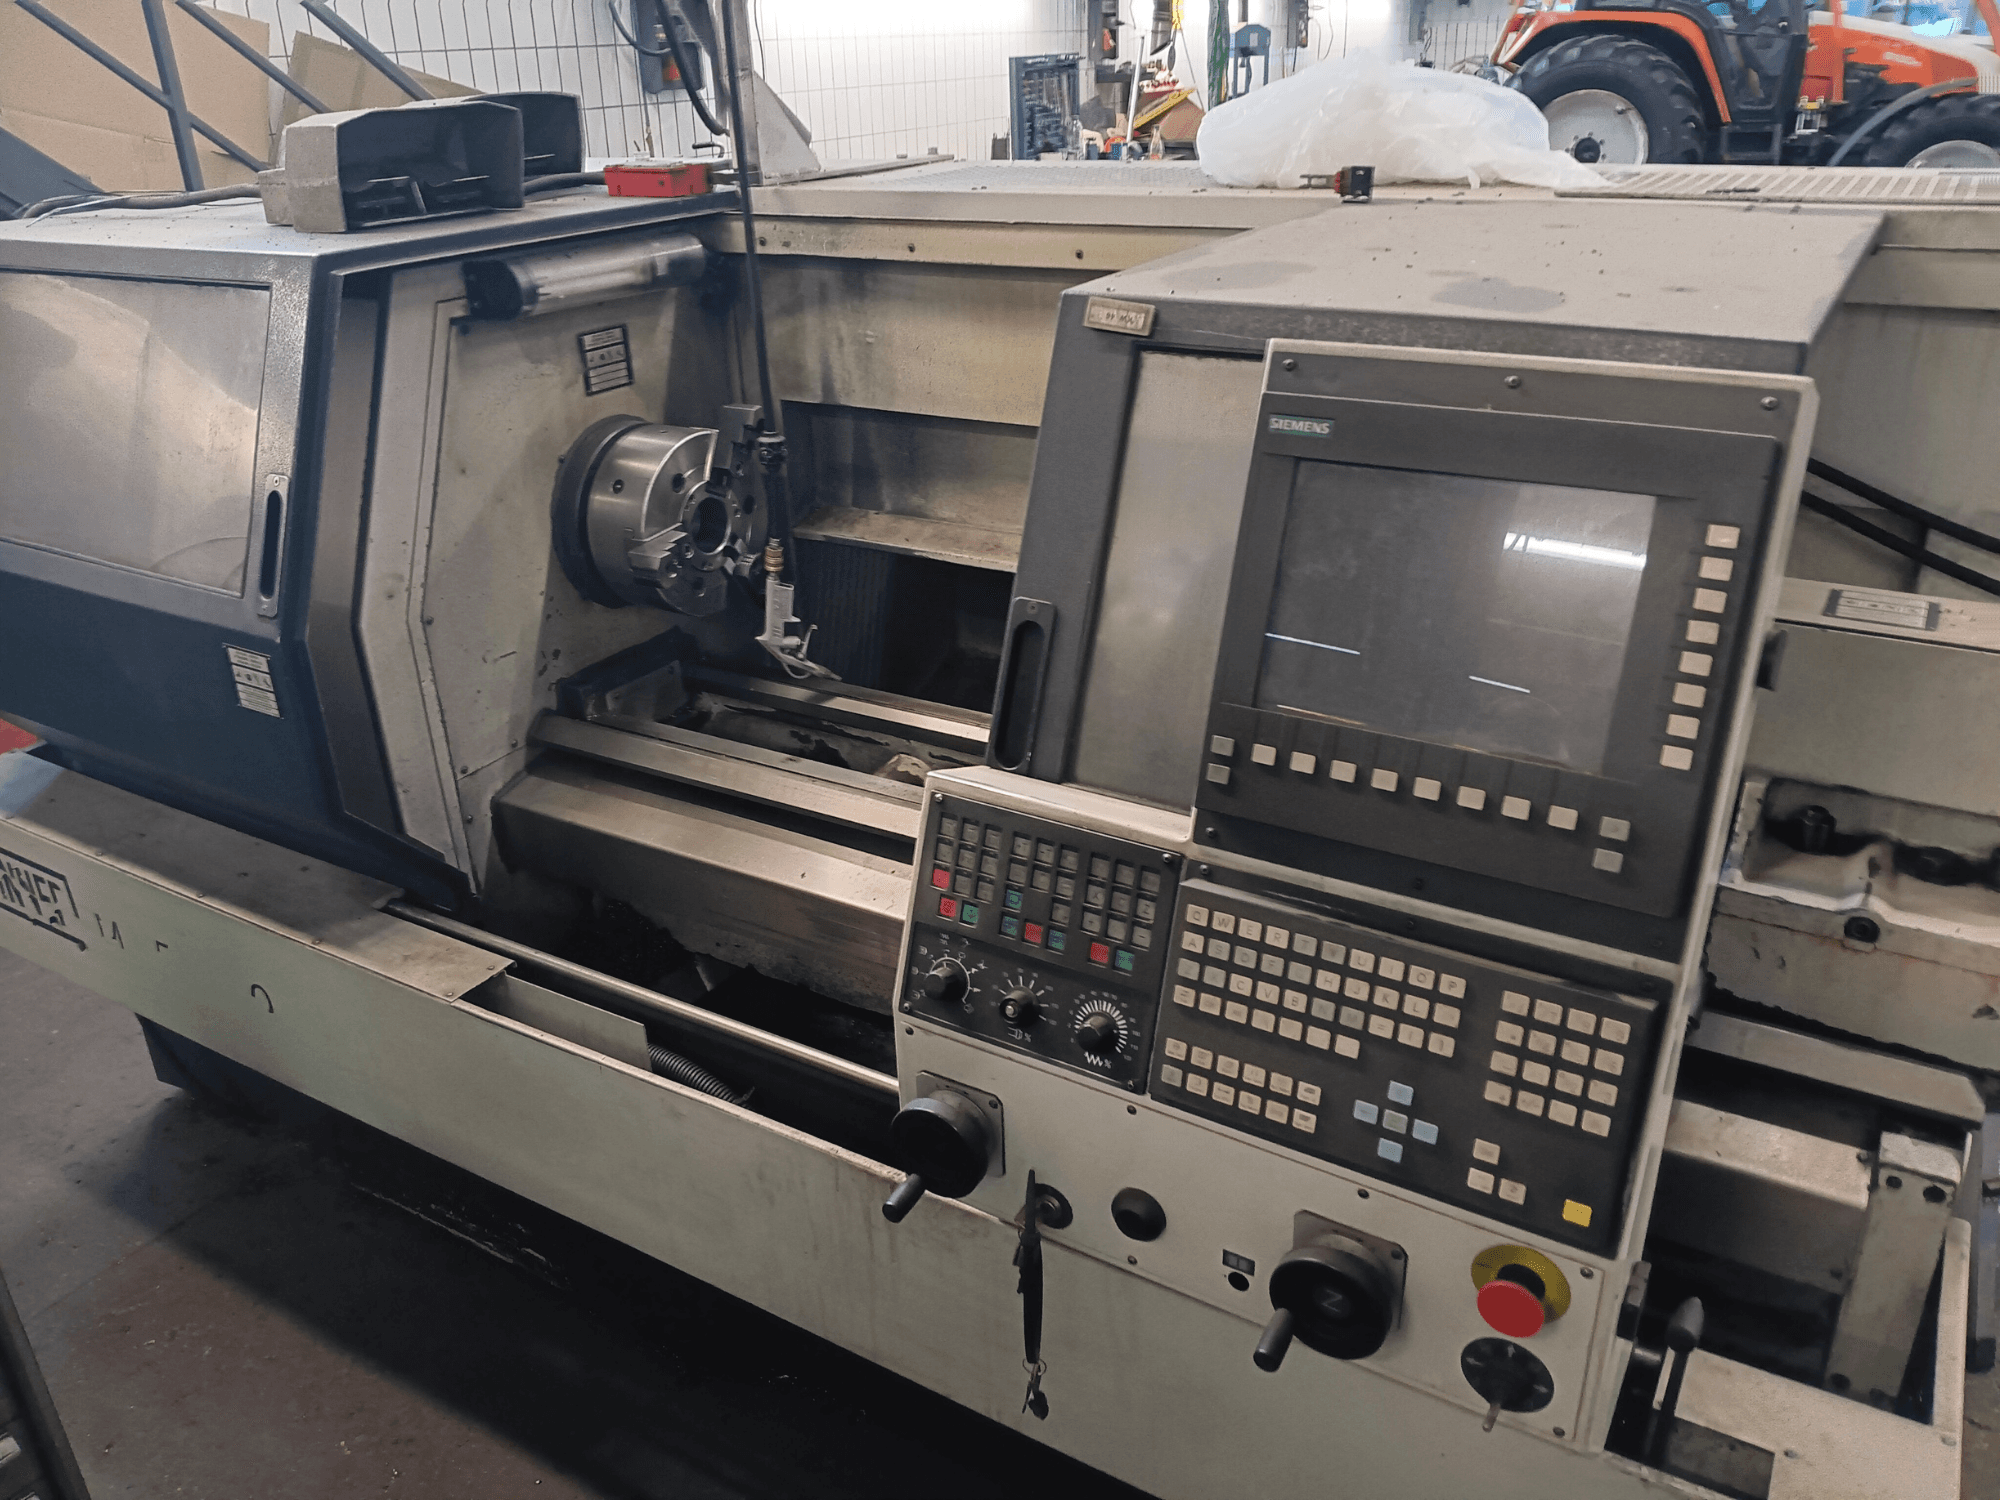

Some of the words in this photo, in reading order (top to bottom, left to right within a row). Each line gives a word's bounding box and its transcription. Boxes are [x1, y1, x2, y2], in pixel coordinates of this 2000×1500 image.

[1270, 417, 1330, 434] SIEMENS
[1217, 916, 1230, 928] W
[1246, 925, 1254, 936] E
[1274, 932, 1282, 943] R
[1300, 939, 1310, 950] T
[1357, 955, 1366, 966] U
[1416, 972, 1428, 984] O
[1448, 980, 1458, 992] P
[1188, 937, 1197, 948] A
[1214, 944, 1222, 955] S
[1323, 975, 1333, 986] H
[1351, 984, 1360, 995] J
[1382, 992, 1390, 1004] K
[1412, 1002, 1420, 1013] L
[1236, 980, 1244, 991] C
[1263, 988, 1272, 1000] V
[1291, 996, 1300, 1008] B
[1321, 1288, 1342, 1313] Z
